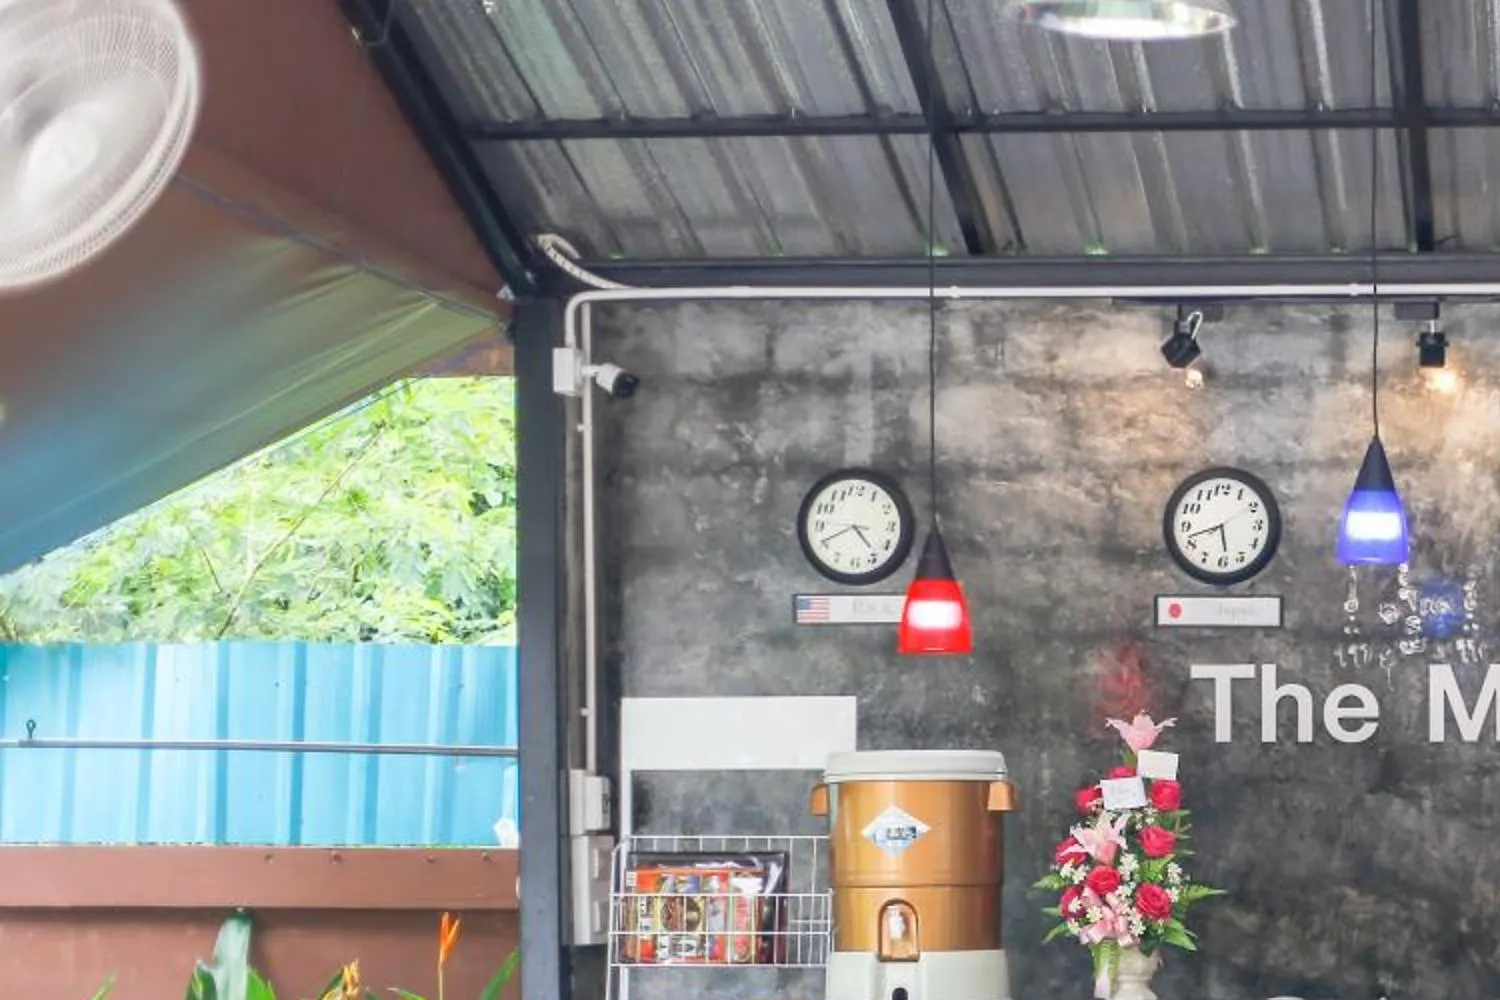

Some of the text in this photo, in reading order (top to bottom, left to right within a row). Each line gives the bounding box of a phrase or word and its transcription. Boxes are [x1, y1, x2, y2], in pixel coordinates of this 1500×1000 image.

[831, 490, 847, 502] 11
[848, 485, 865, 497] 12
[1197, 488, 1212, 501] 11
[1214, 484, 1231, 497] 12
[816, 503, 835, 515] 10
[882, 503, 892, 515] 2
[1182, 503, 1201, 515] 10
[1248, 501, 1259, 514] 2
[1181, 521, 1192, 533] 9
[1252, 519, 1263, 531] 3
[1248, 537, 1259, 550] 4
[850, 557, 860, 568] 6
[867, 553, 878, 565] 5
[1217, 556, 1229, 568] 6
[1235, 551, 1246, 563] 5
[1190, 663, 1380, 743] The
